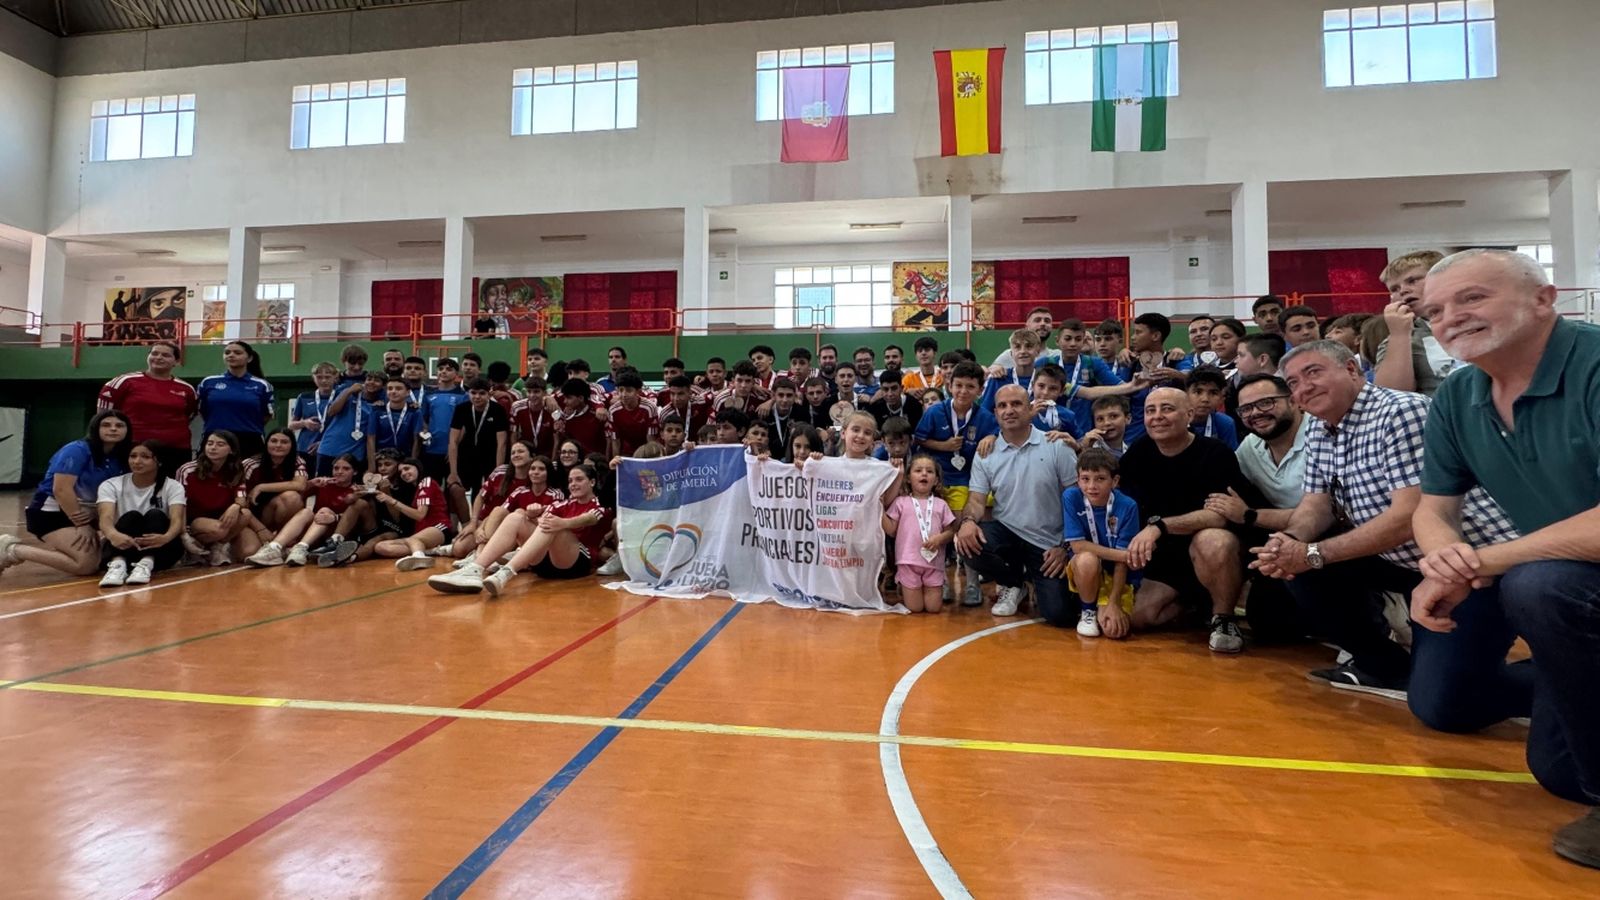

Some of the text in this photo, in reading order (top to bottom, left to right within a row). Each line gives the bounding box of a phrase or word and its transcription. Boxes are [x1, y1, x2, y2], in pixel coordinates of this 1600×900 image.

[666, 481, 678, 492] DE
[758, 474, 808, 499] JUEGOS
[817, 478, 854, 491] TALLERES
[816, 491, 865, 503] ENCUENTROS
[816, 504, 837, 516] LIGAS
[816, 517, 854, 530] CIRCUITOS
